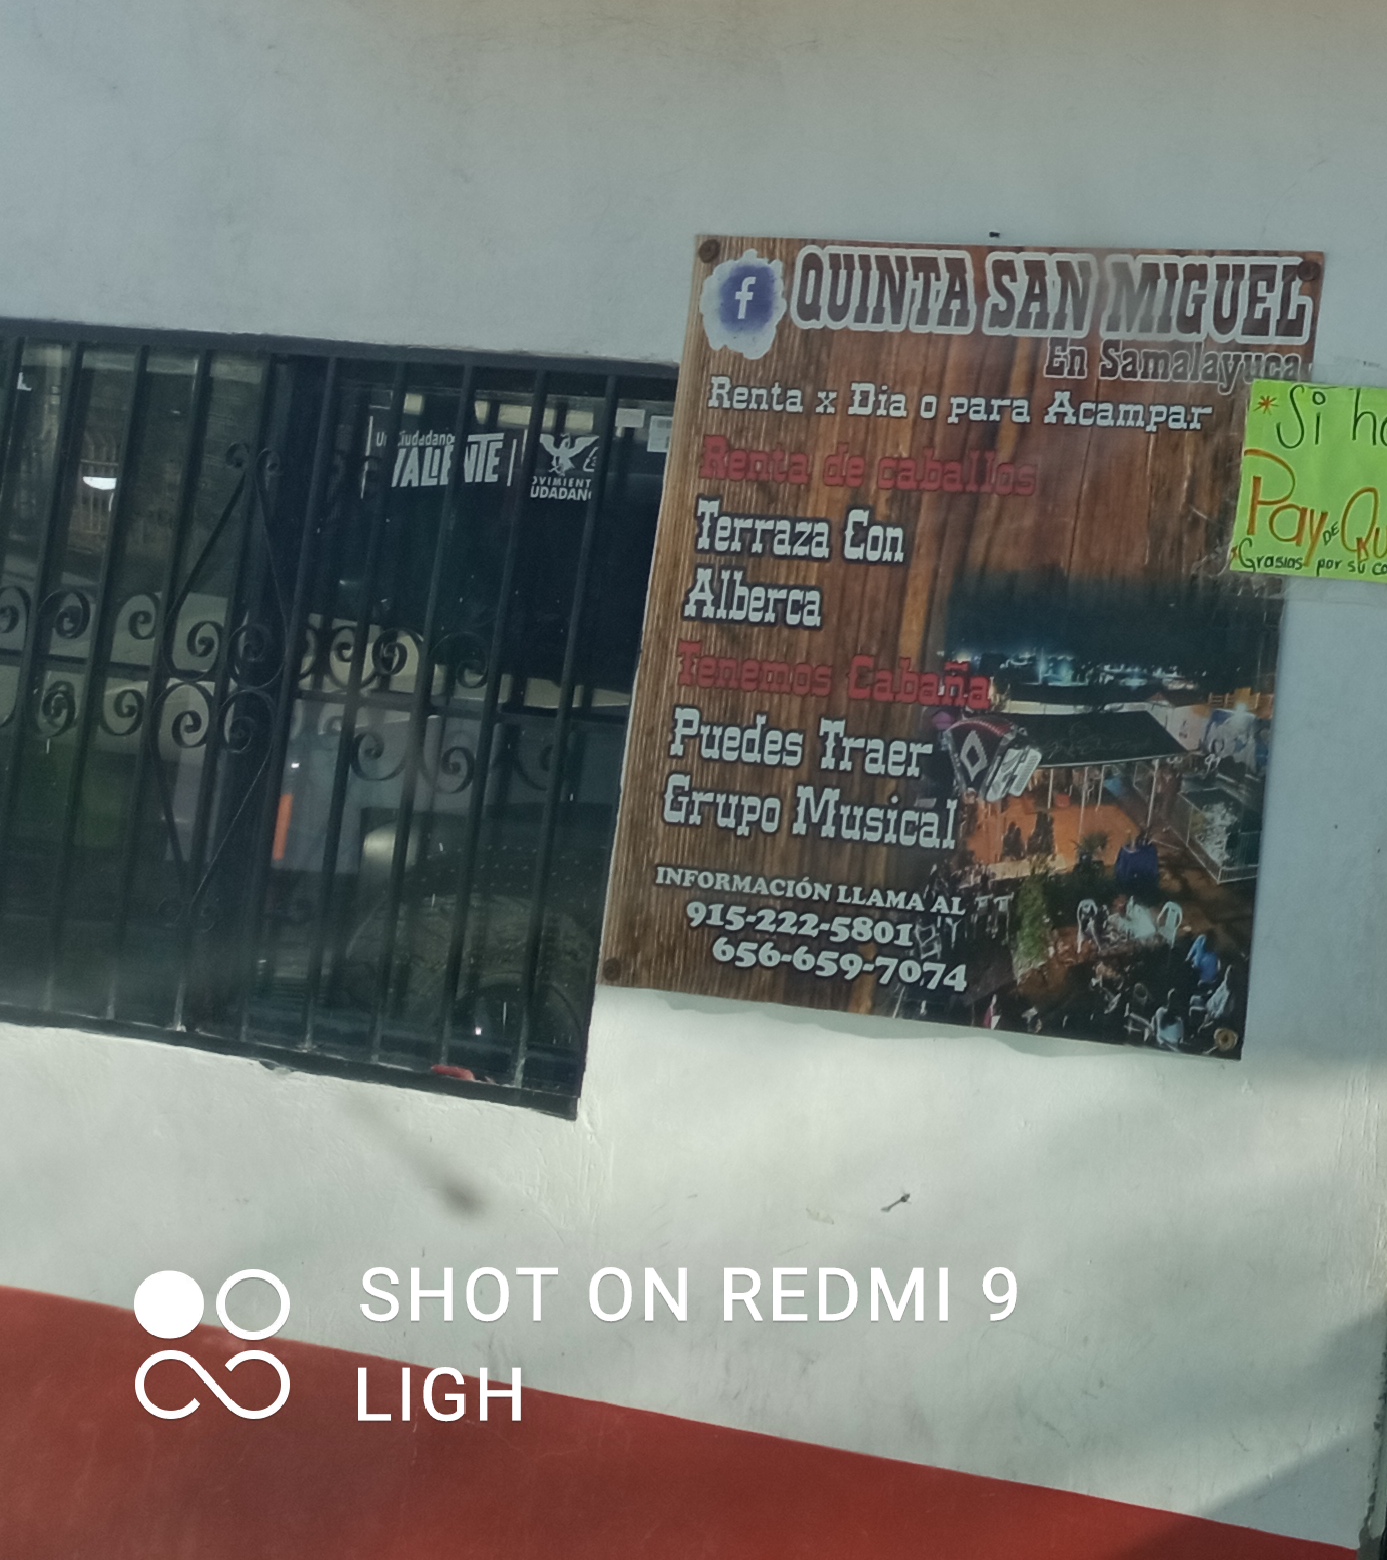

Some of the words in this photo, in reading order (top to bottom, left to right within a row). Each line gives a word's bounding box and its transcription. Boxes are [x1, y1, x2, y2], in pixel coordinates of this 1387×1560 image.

[796, 248, 972, 331] QUINTA
[986, 255, 1095, 334] SAN
[1104, 258, 1310, 340] MIGUEL
[1044, 339, 1087, 380] En
[1100, 339, 1302, 395] Samalayuca
[708, 377, 804, 414] Renta
[816, 392, 836, 415] x
[849, 383, 907, 417] Dia
[921, 397, 936, 419] o
[948, 395, 1031, 426] para
[1045, 391, 1212, 431] Acampar
[1276, 385, 1326, 449] Si
[398, 430, 455, 447] iudadano
[702, 436, 809, 482] Renta
[823, 443, 864, 487] de
[879, 446, 1037, 496] caballos
[530, 486, 592, 501] UDADAN
[532, 476, 591, 488] VIMIENT
[1244, 449, 1328, 567] Pay
[1323, 521, 1340, 545] DE
[697, 499, 830, 558] Terraza
[844, 509, 904, 562] Con
[1239, 537, 1303, 572] Grasias
[1316, 559, 1343, 577] por
[1349, 559, 1366, 574] su
[684, 567, 821, 627] Alberca
[677, 641, 832, 696] Tenemos
[847, 654, 991, 710] Cabaña
[669, 706, 804, 766] Puedes
[819, 718, 933, 777] Traer
[664, 774, 780, 836] Grupo
[792, 785, 957, 849] Musical
[656, 866, 831, 901] INFORMACIÓN
[837, 886, 924, 912] LLAMA
[931, 896, 966, 915] AL
[686, 901, 914, 947] 915-222-5801
[712, 937, 967, 991] 656-659-7074
